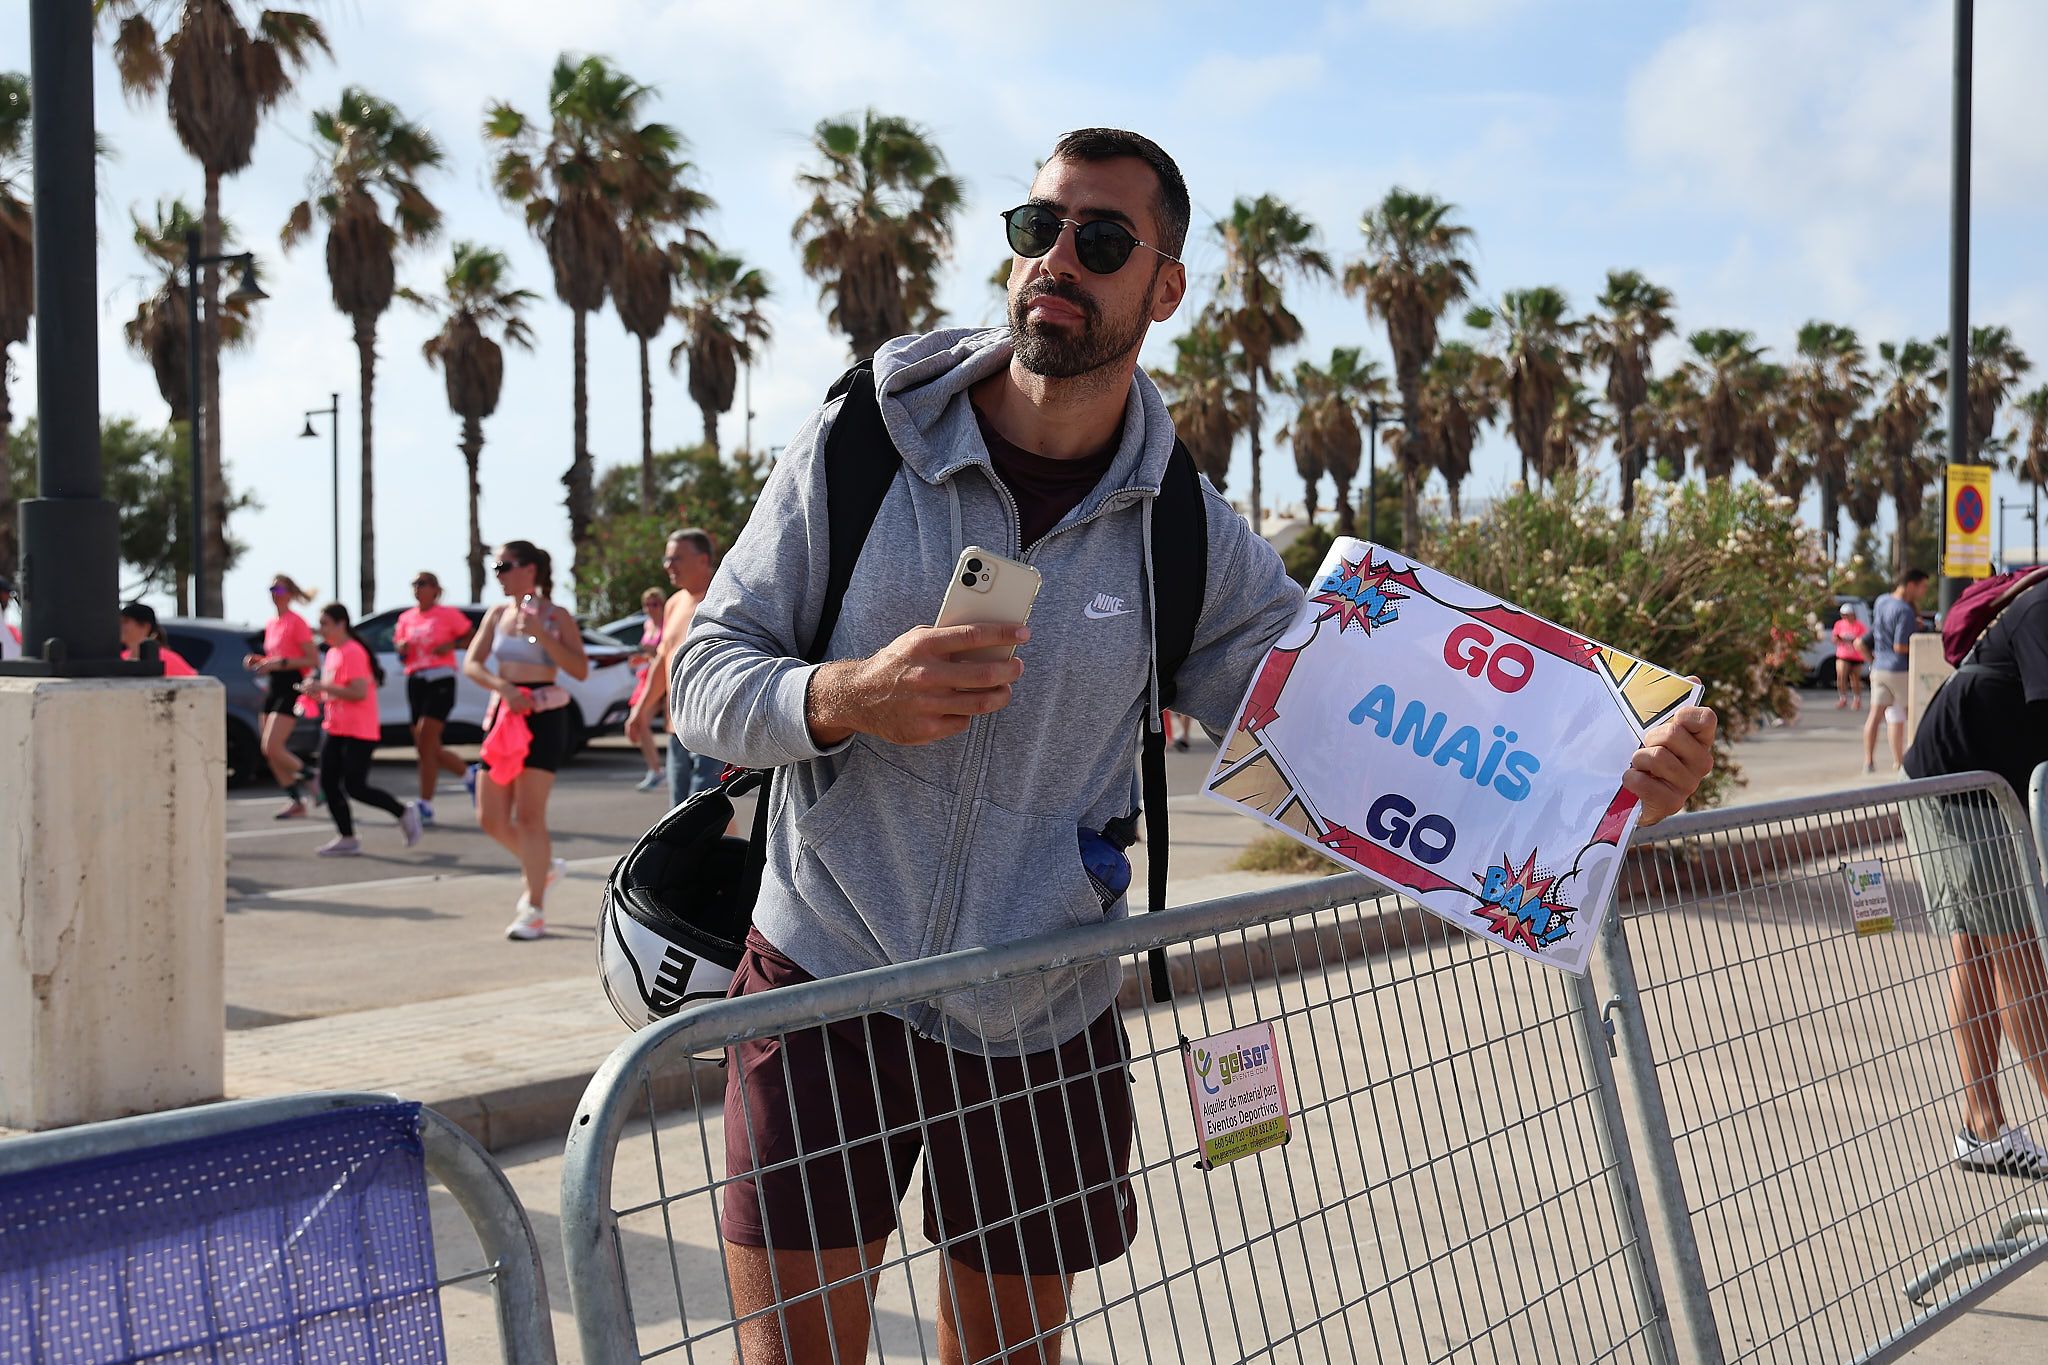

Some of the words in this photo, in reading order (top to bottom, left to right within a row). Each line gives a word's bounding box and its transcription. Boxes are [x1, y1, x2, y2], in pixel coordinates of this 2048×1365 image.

[1092, 592, 1125, 612] NIKE
[1319, 564, 1399, 628] BAM!
[1444, 623, 1535, 693] GO
[1348, 684, 1541, 802] ANAÏS
[1366, 793, 1456, 864] GO
[1481, 866, 1569, 947] BAM!
[1219, 1044, 1270, 1086] geiser
[1232, 1066, 1269, 1083] EVENTS.COM
[1203, 1097, 1227, 1117] Alquiler
[1228, 1093, 1237, 1108] de
[1237, 1086, 1264, 1104] material
[1263, 1083, 1278, 1101] para
[1207, 1115, 1238, 1135] Eventos
[1239, 1101, 1279, 1125] Deportivos
